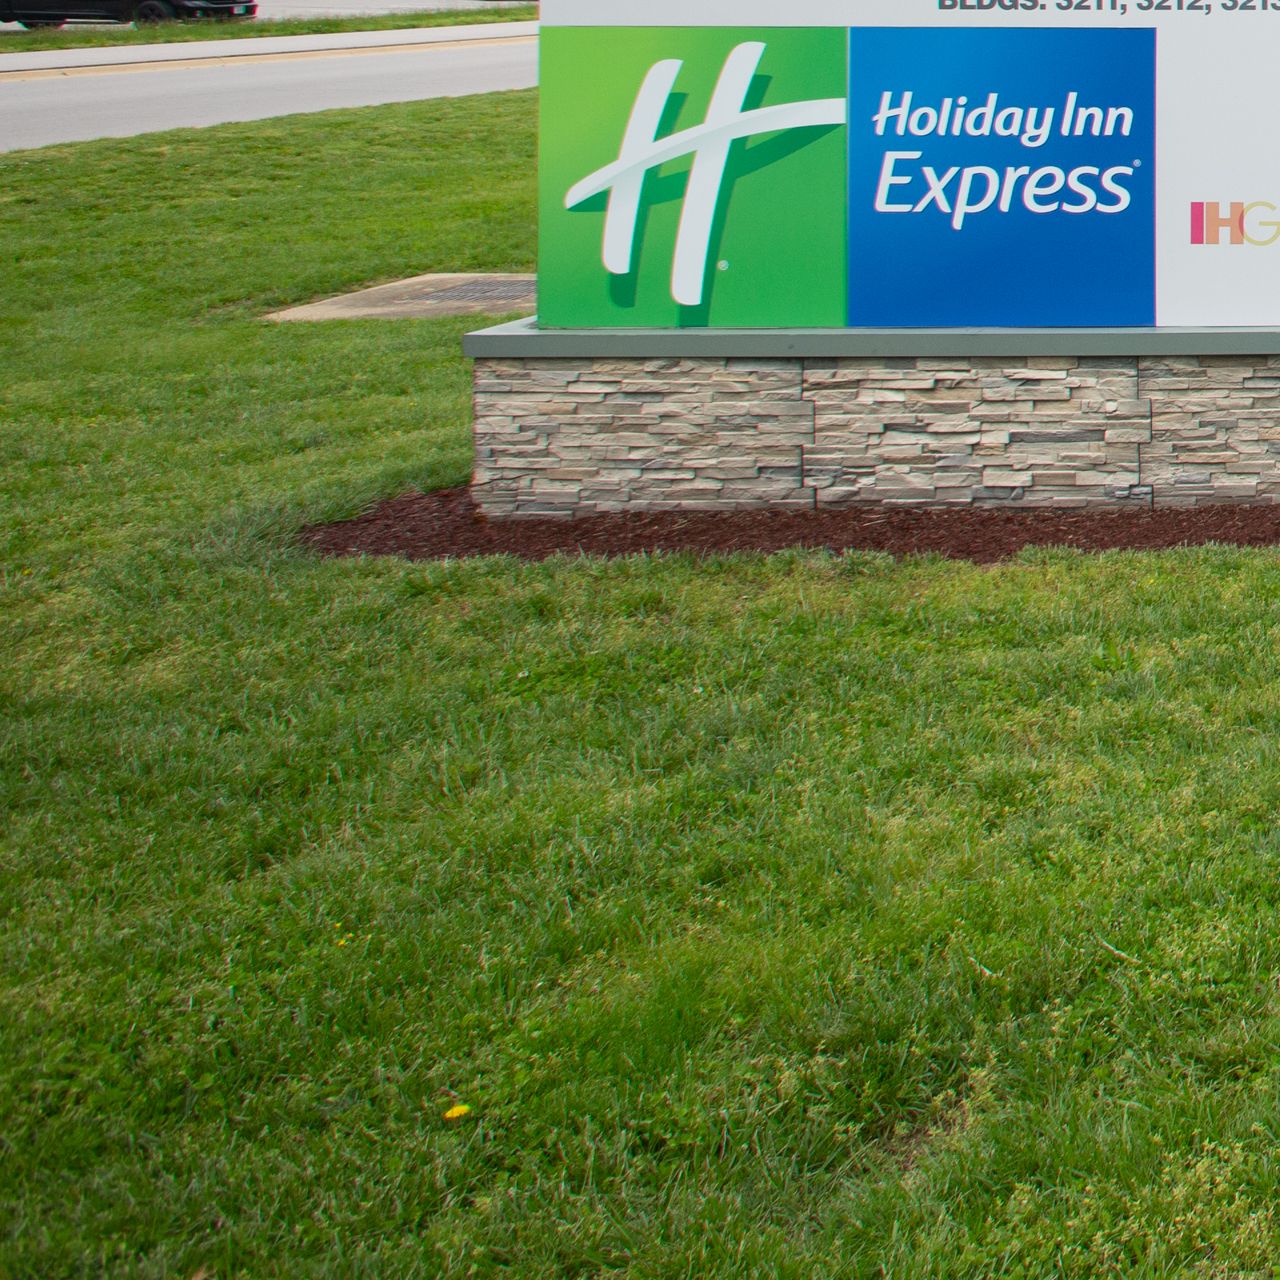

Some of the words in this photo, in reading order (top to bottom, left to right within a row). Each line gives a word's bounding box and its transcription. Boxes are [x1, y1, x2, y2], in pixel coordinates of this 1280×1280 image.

[872, 91, 1055, 147] Holiday
[1061, 91, 1134, 136] Inn
[874, 150, 1134, 230] Express
